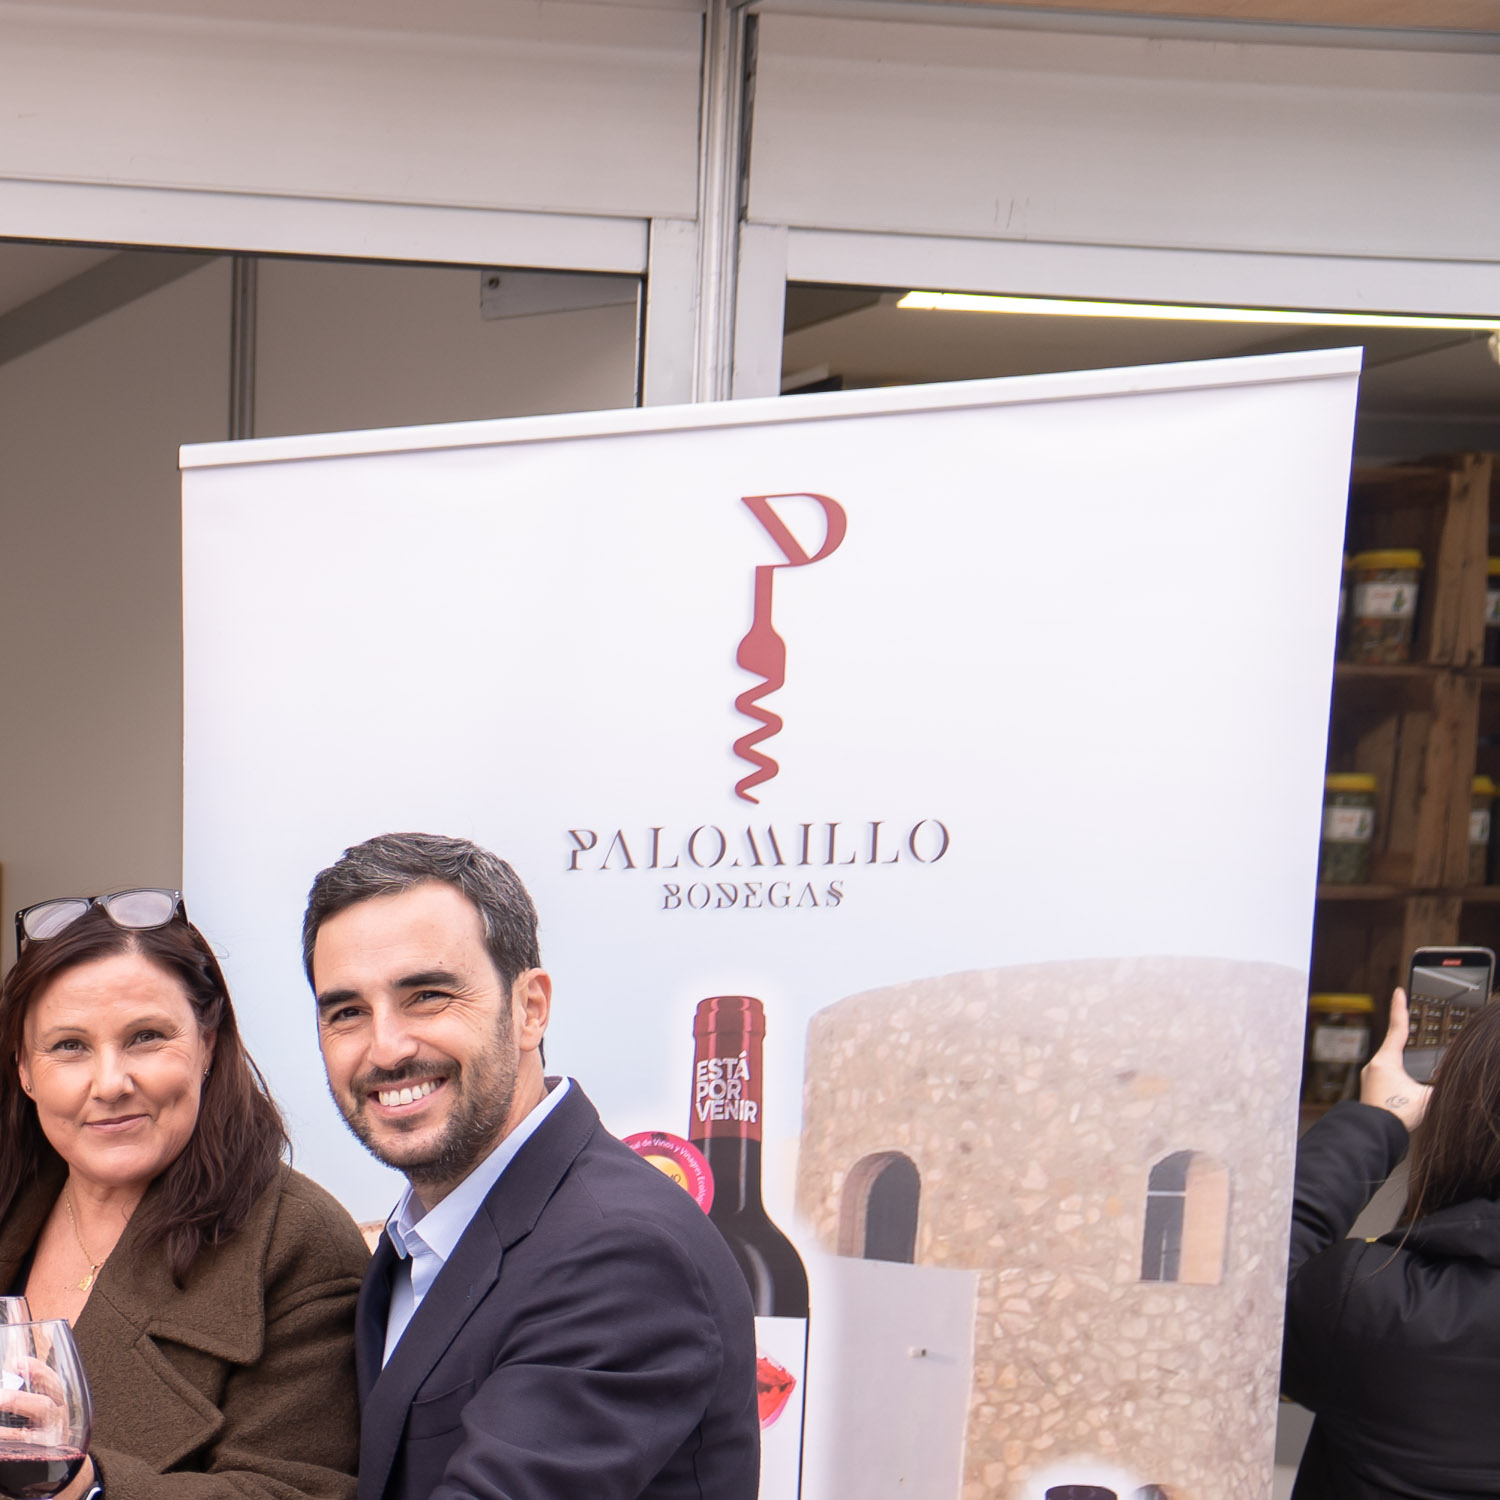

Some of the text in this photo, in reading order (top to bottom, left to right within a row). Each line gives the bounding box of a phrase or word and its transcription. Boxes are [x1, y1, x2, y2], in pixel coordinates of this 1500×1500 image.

[565, 819, 950, 871] PALOMILLO
[662, 880, 844, 910] BODEGAS
[696, 1050, 750, 1082] ESTÁ
[696, 1079, 743, 1103] POR
[695, 1099, 759, 1123] VENIR
